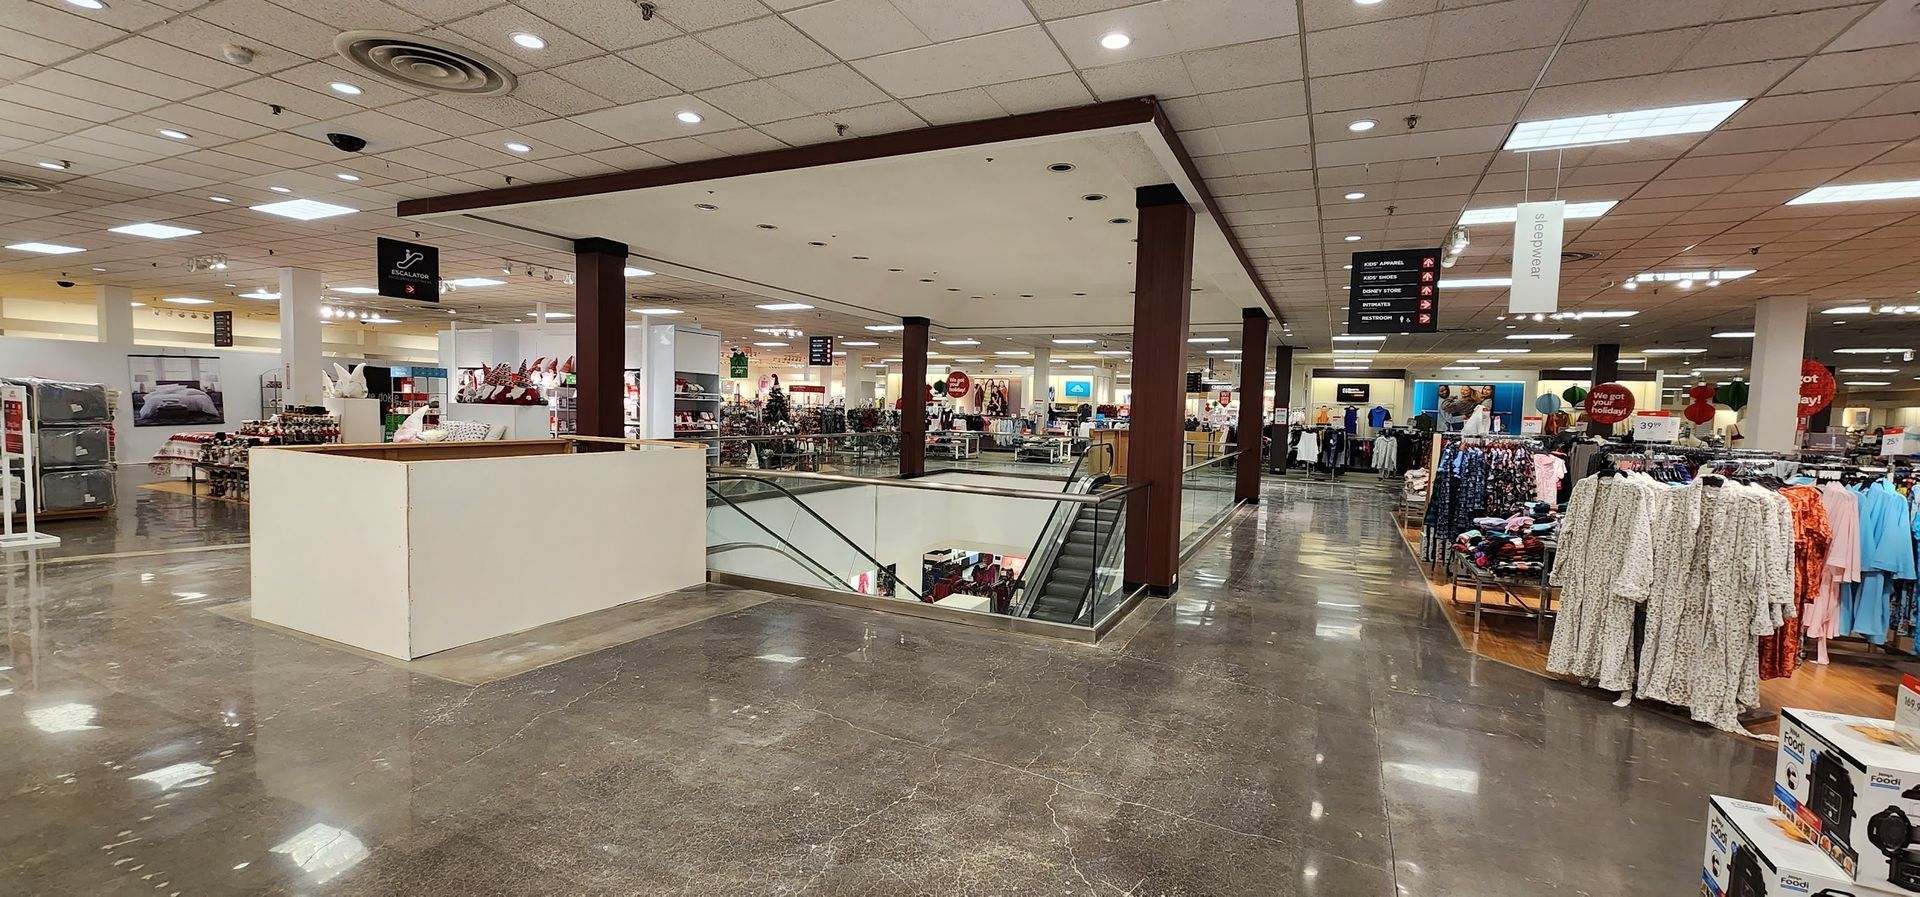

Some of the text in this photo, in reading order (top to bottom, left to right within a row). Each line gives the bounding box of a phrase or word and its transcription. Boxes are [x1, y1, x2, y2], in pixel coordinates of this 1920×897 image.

[1530, 213, 1548, 280] sleepwear
[391, 269, 430, 280] ESCALATOR
[1591, 407, 1627, 416] holiday!
[1784, 731, 1805, 756] Foodi
[1871, 775, 1901, 786] Foodi
[1711, 818, 1728, 845] Foodi
[1780, 877, 1809, 889] Foodi
